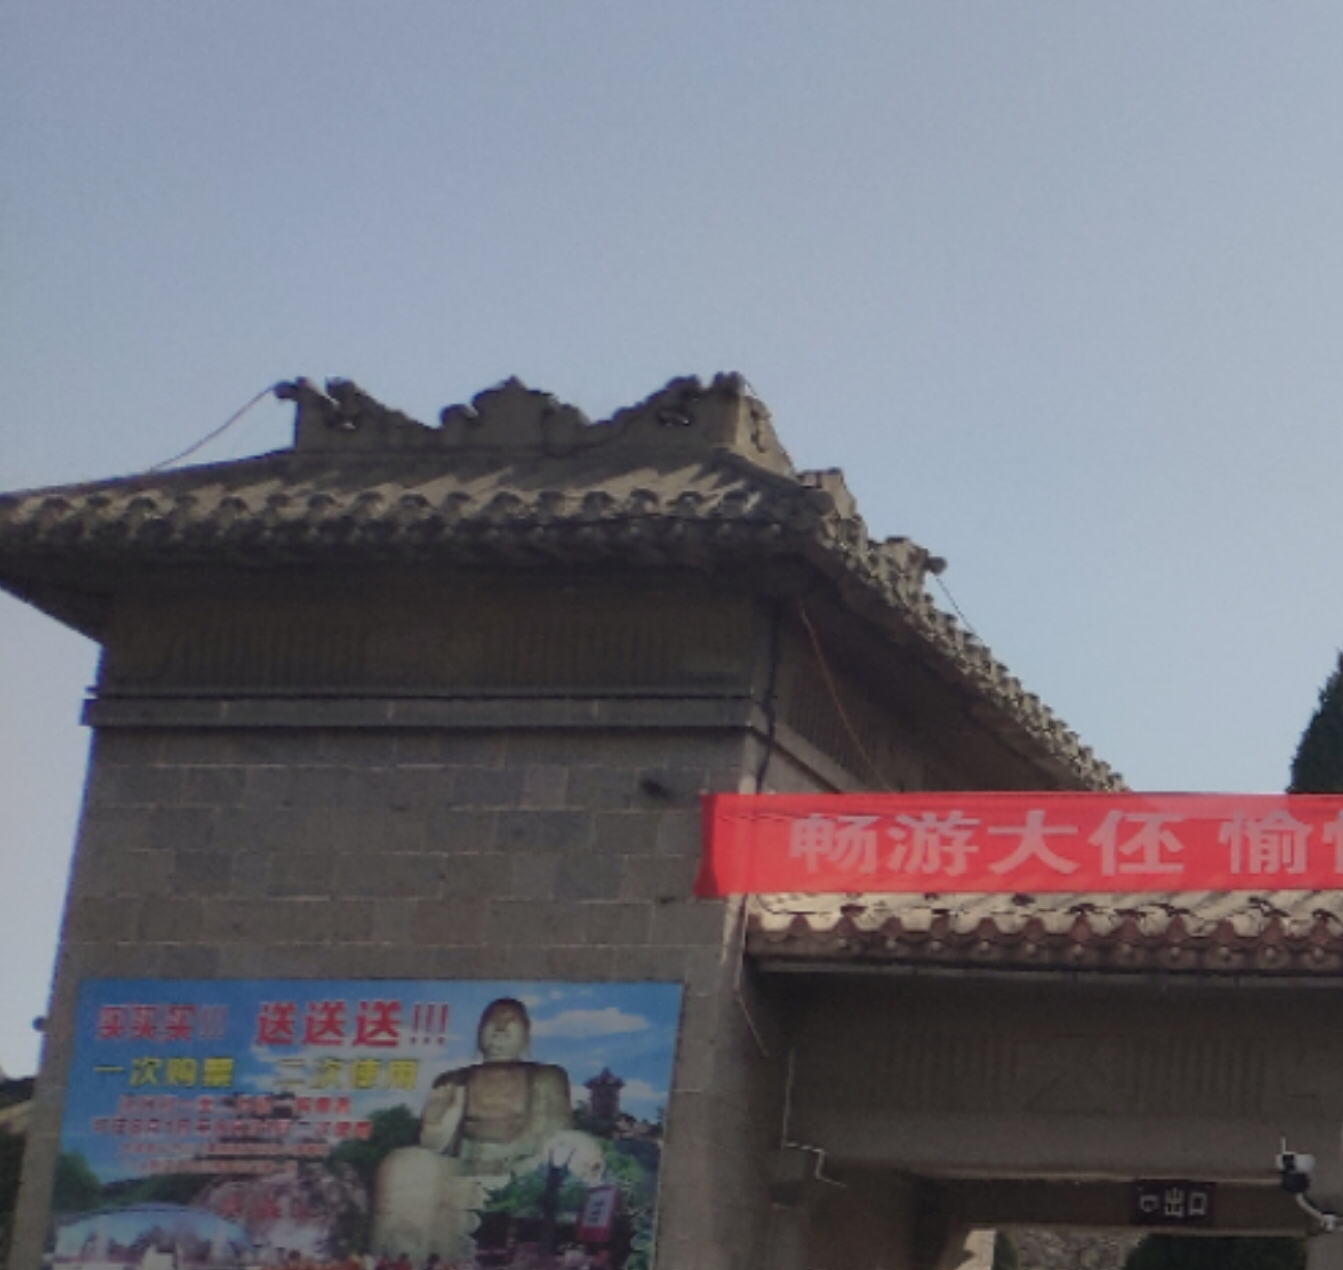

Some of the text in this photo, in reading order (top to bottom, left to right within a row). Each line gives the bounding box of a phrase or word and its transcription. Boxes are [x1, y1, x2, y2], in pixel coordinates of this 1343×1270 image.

[791, 808, 1185, 876] 畅游大伾
[94, 1057, 417, 1090] 一次购票 二次使用
[1164, 1187, 1207, 1218] 出口
